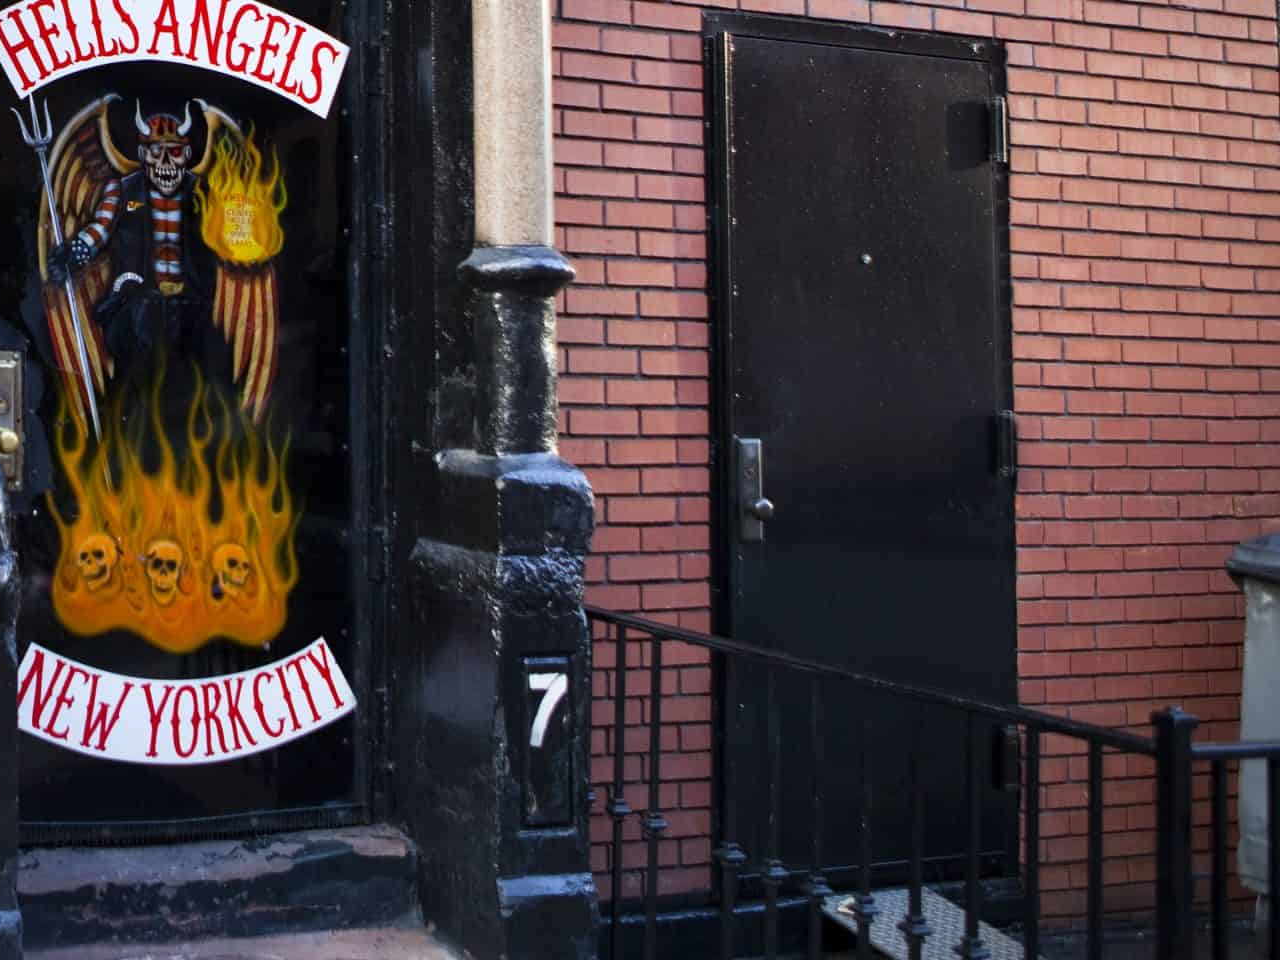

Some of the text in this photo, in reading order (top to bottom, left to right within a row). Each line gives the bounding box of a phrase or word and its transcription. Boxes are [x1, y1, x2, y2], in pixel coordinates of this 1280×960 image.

[17, 642, 344, 758] NEW YORK CITY
[528, 672, 568, 748] 7
